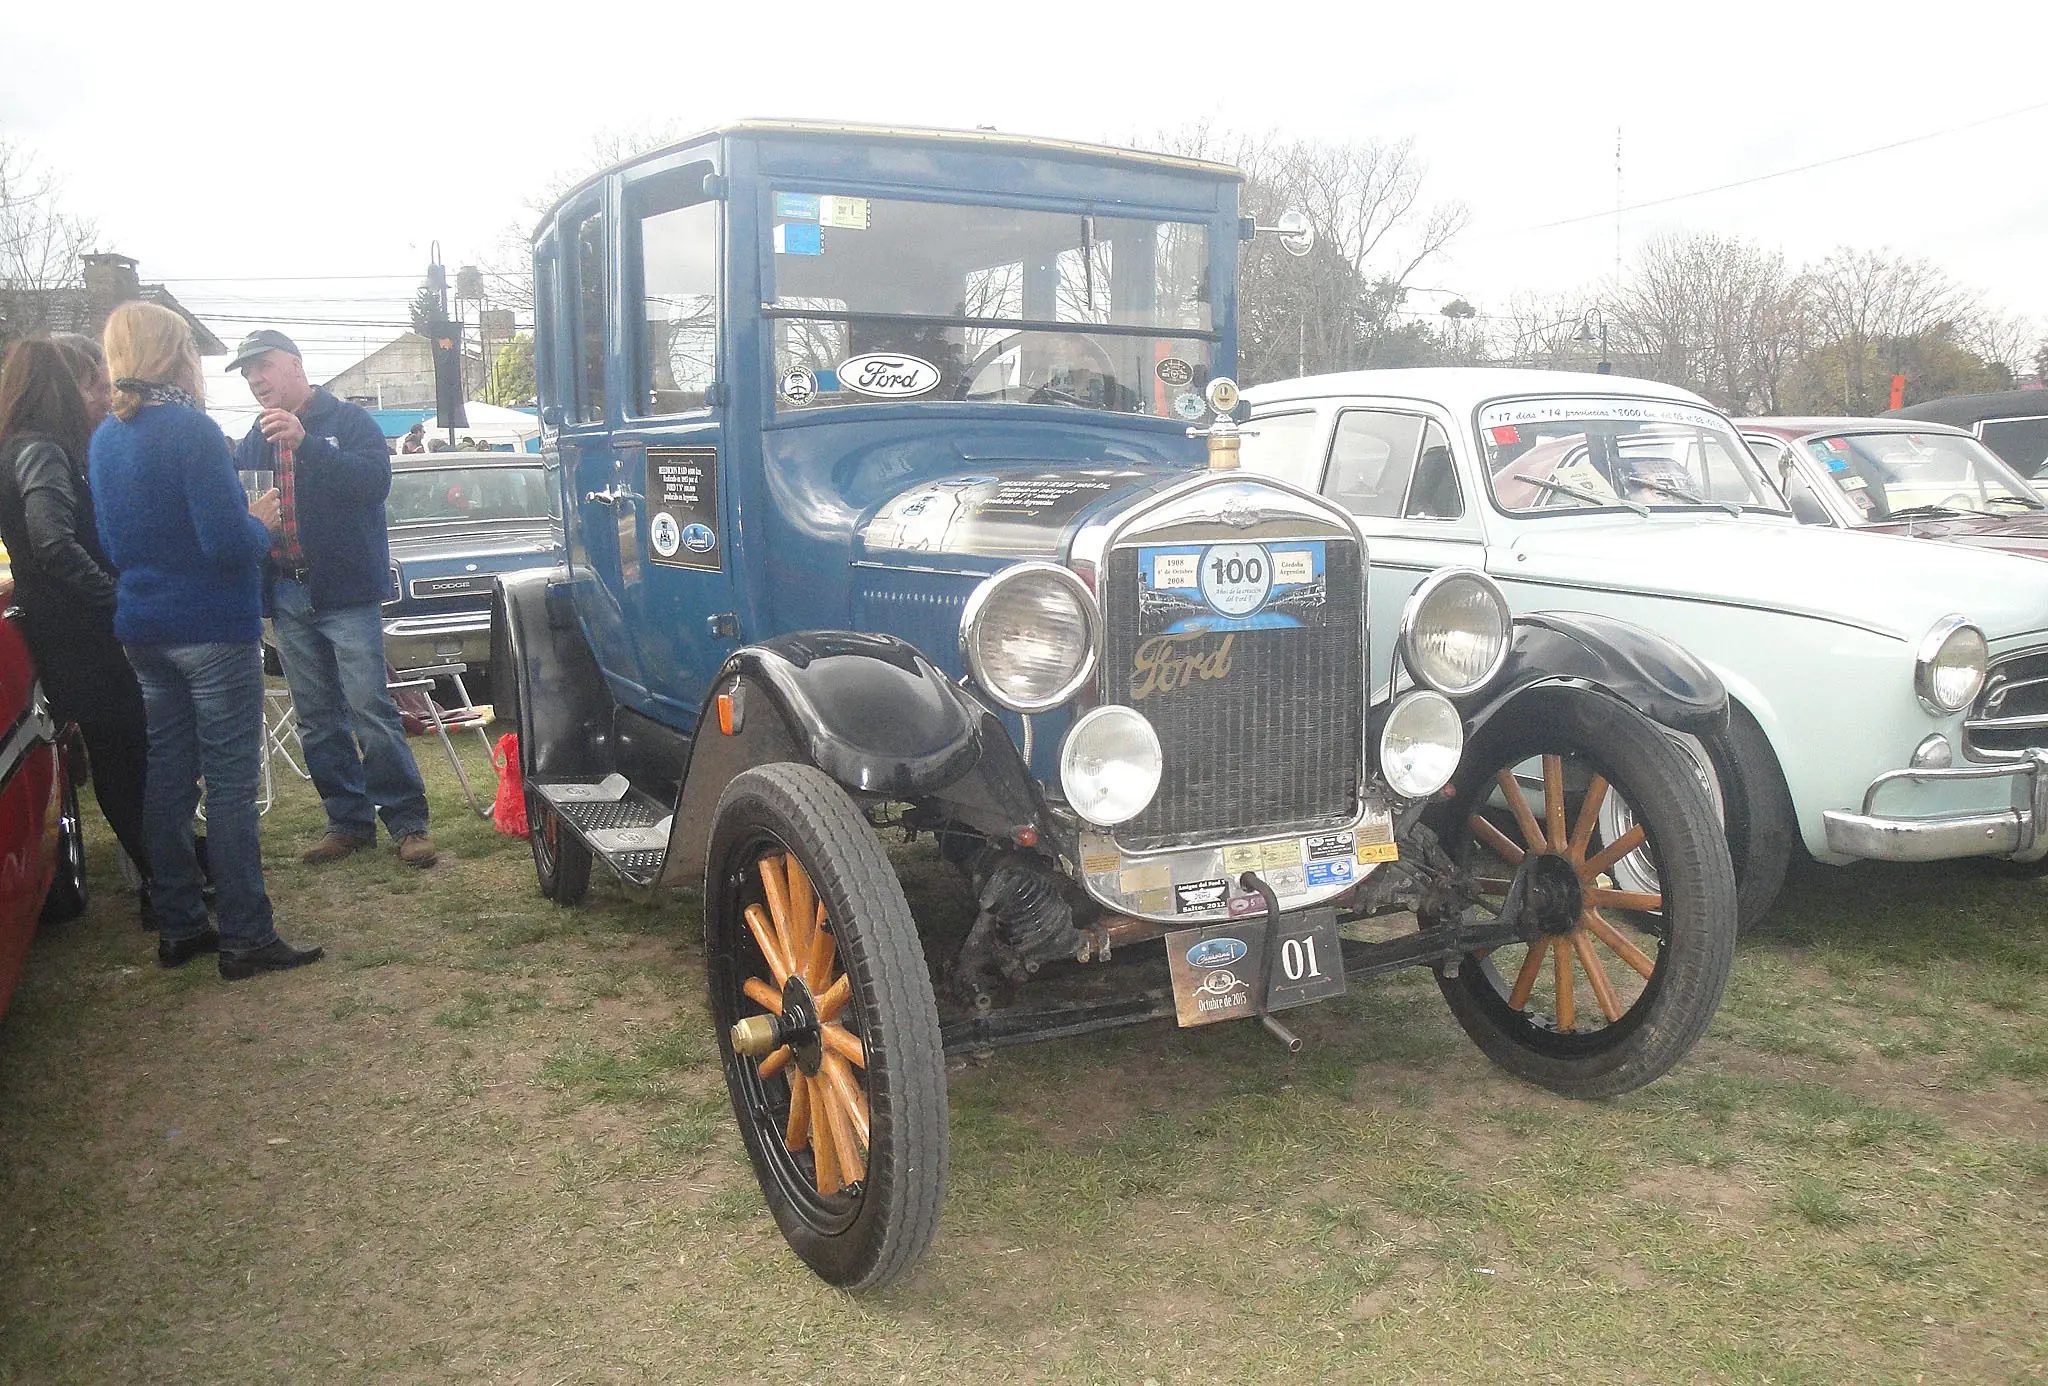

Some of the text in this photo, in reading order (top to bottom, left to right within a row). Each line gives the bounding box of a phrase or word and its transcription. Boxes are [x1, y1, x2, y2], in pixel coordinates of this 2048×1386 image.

[859, 361, 919, 388] Ford
[1211, 557, 1262, 584] 100
[432, 582, 470, 590] DODGE
[1129, 628, 1235, 700] Ford
[1206, 901, 1226, 909] 2012
[1281, 935, 1322, 981] 01
[1198, 992, 1247, 1012] Octubre de 2015
